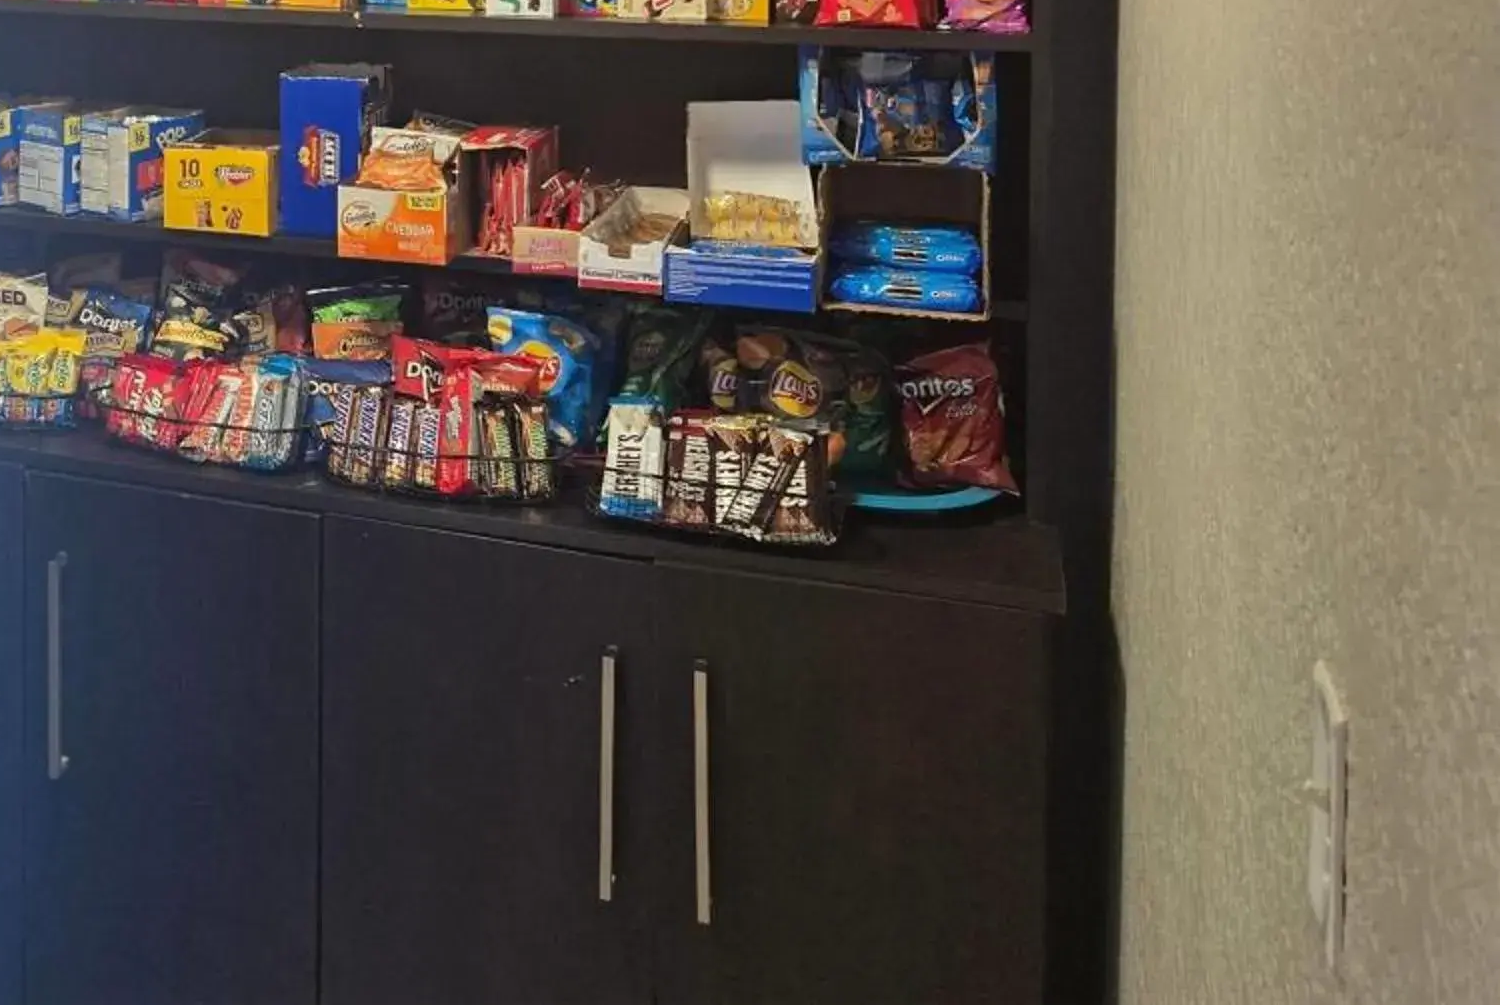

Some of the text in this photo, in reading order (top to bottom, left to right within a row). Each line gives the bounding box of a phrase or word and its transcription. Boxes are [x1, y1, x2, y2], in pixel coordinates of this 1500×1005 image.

[179, 158, 200, 178] 10
[901, 376, 975, 399] oritos
[360, 392, 382, 465] SNICKES
[615, 433, 643, 496] ERHEY'S
